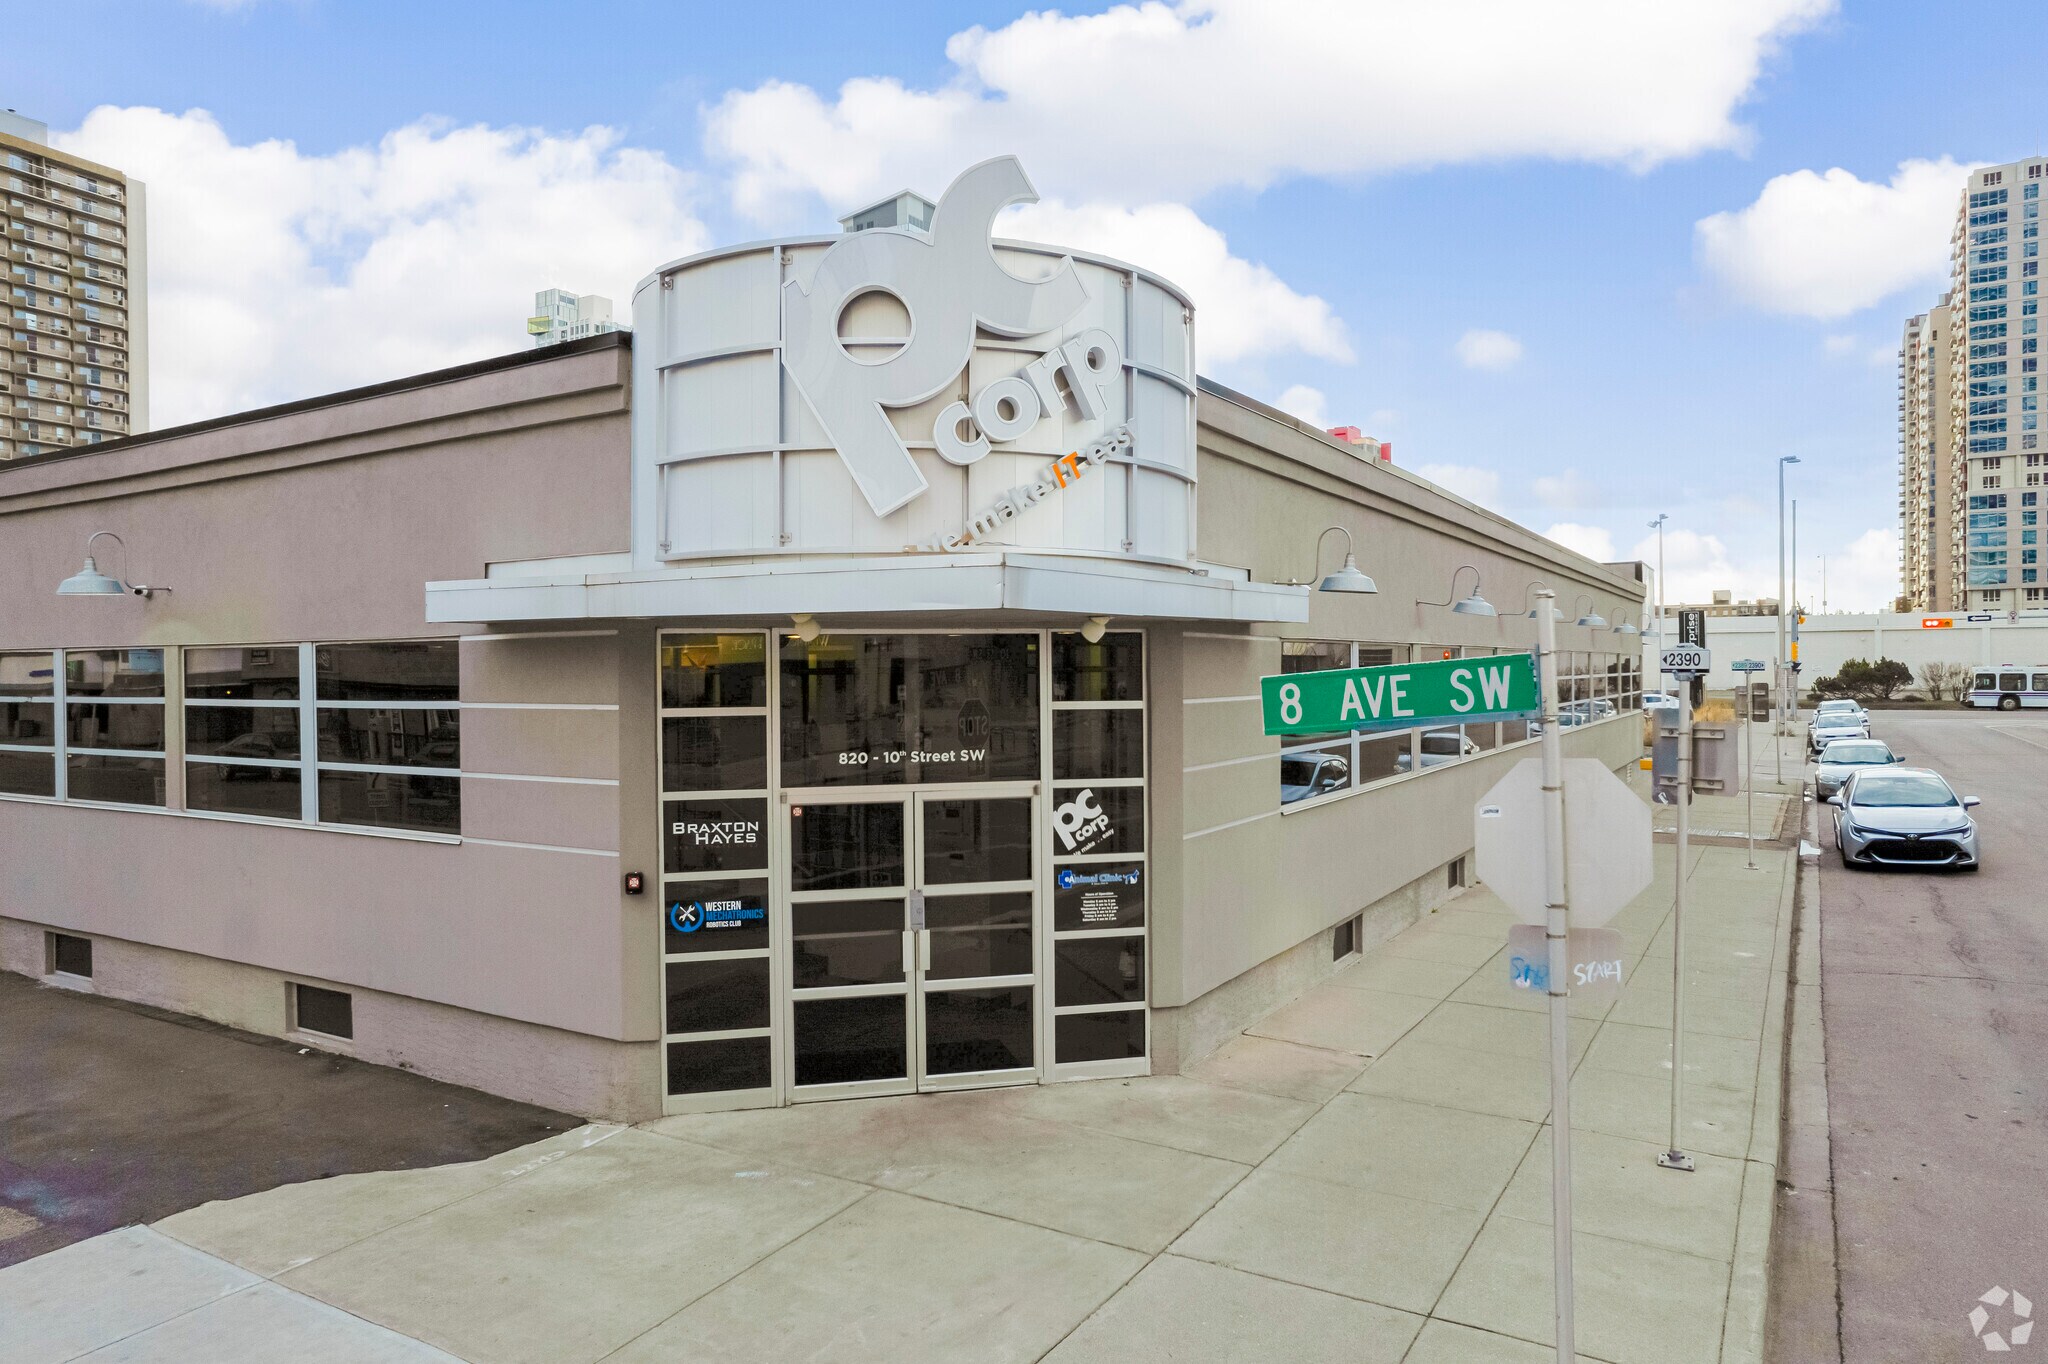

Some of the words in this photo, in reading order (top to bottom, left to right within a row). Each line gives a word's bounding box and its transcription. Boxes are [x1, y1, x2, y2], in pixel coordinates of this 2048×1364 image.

[933, 328, 1122, 465] corp
[965, 480, 1048, 540] make
[1052, 451, 1081, 489] IT
[1668, 653, 1701, 667] 2390
[1279, 682, 1303, 725] 8
[1340, 674, 1414, 721] AVE
[1450, 665, 1511, 713] SW
[838, 752, 868, 765] 820
[883, 750, 906, 764] 10th
[910, 750, 956, 763] Street
[960, 749, 986, 762] SW
[673, 821, 759, 834] BRAXTON
[1075, 814, 1109, 841] corp
[695, 832, 757, 845] HAYES
[705, 900, 742, 911] WESTERN
[705, 908, 764, 921] MECHATRONICS
[706, 920, 729, 928] ROBOTICS
